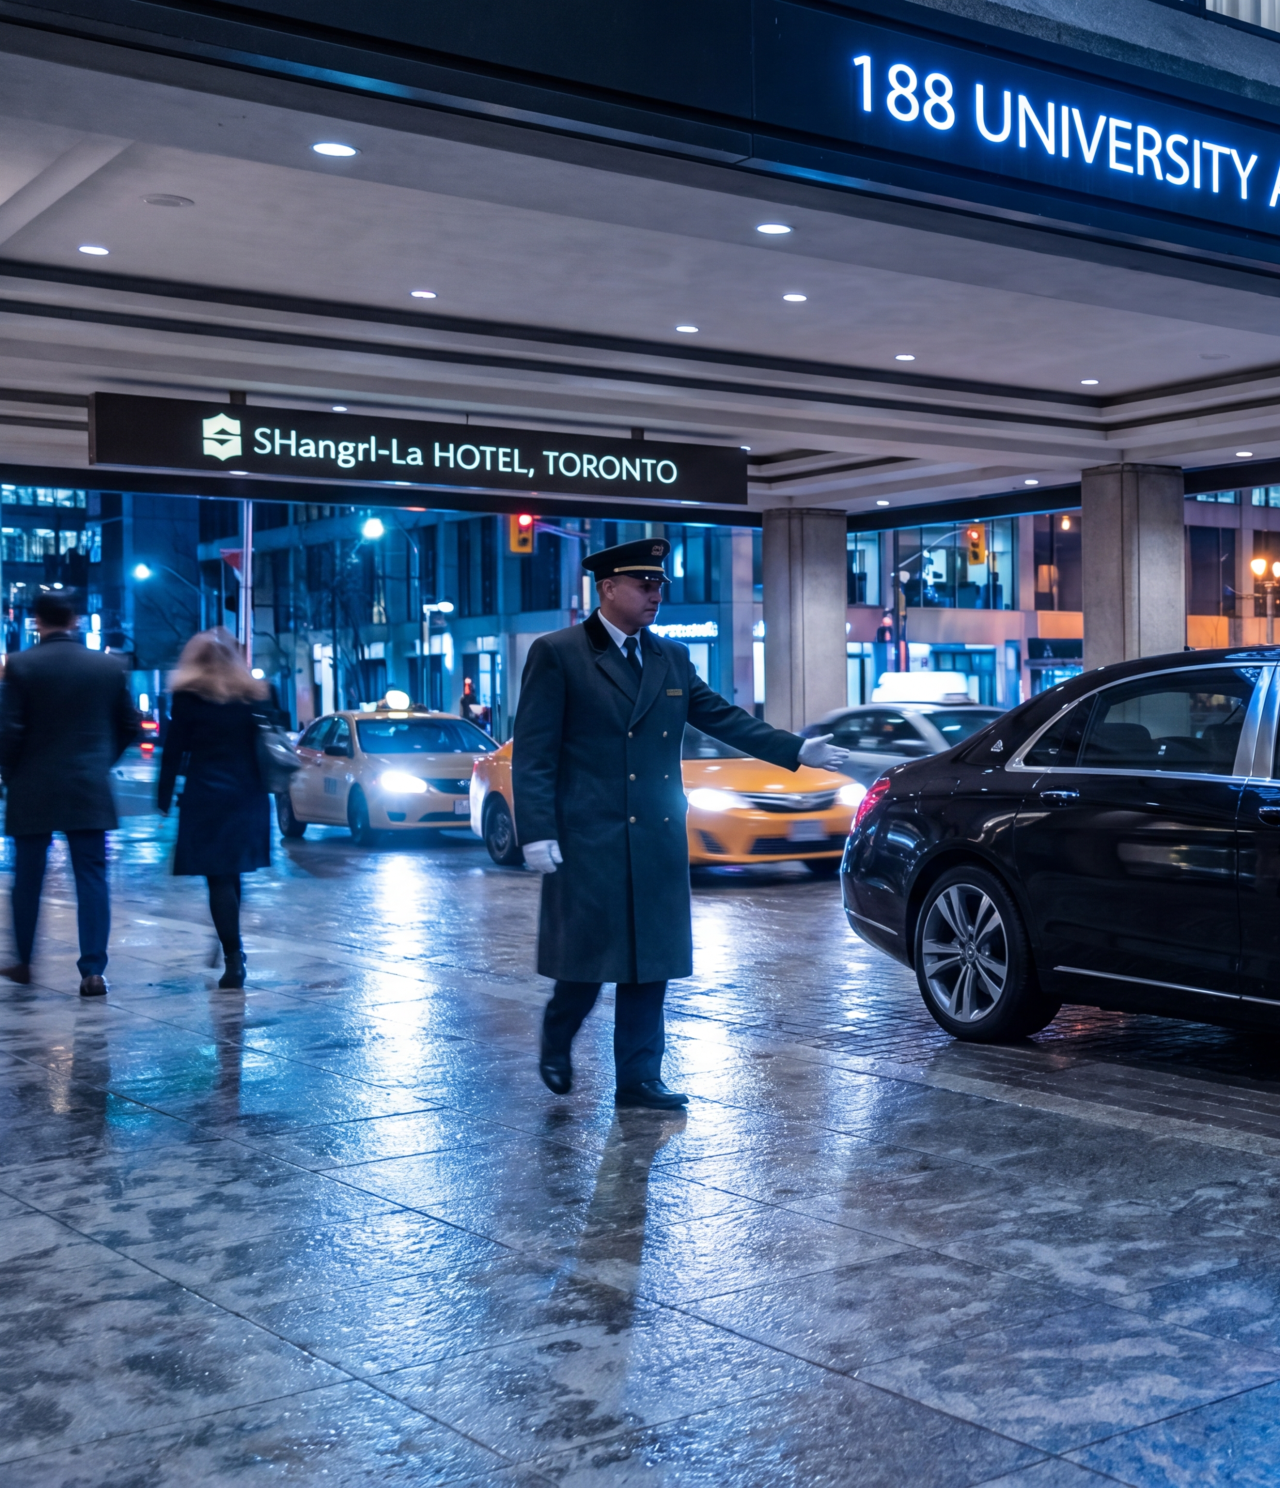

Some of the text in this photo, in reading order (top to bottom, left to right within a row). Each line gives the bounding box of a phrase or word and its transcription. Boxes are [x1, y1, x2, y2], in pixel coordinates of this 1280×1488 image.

[853, 54, 956, 131] 188
[975, 83, 1258, 200] UNIVERSITY
[433, 442, 535, 478] HOTEL,
[542, 450, 679, 484] TORONTO
